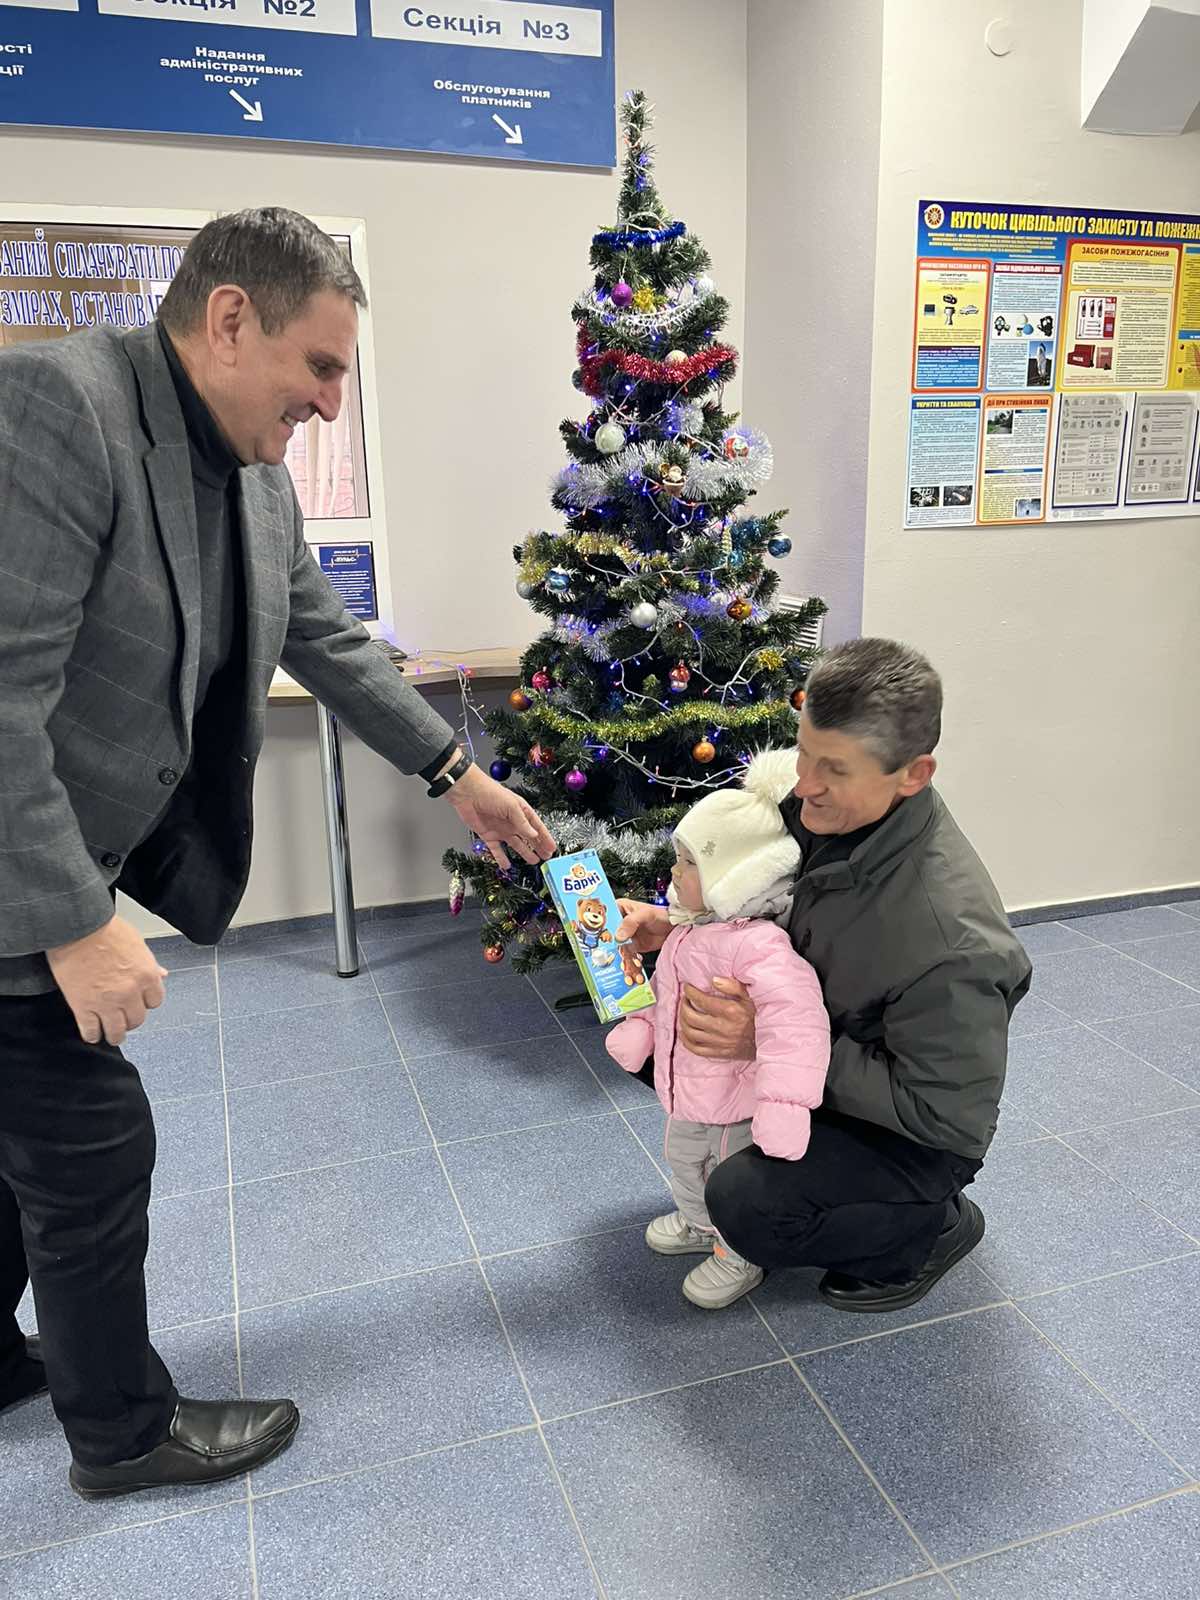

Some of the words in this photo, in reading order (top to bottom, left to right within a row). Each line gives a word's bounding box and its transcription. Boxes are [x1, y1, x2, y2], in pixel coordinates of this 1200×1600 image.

[264, 0, 316, 17] №2
[403, 8, 501, 36] Секція
[523, 20, 570, 41] №3
[0, 44, 33, 54] сті
[195, 47, 266, 62] Надання
[160, 57, 303, 77] адміністративних
[204, 73, 259, 87] послуг
[433, 79, 551, 99] Обслуговування
[461, 94, 532, 109] платників
[951, 211, 1008, 230] КУТОЧОК
[1009, 213, 1086, 233] ЦИВІЛЬНОГО
[1087, 217, 1138, 236] ЗАХИСТУ
[1140, 220, 1154, 237] ТА
[0, 228, 52, 277] АНИЙ
[55, 242, 158, 280] СПЛАЧУВАТИ
[160, 246, 188, 281] ПО
[1082, 247, 1109, 255] ЗАСОБИ
[1110, 248, 1170, 257] ПОЖЕЖОГАСІННЯ
[564, 871, 601, 892] Барні
